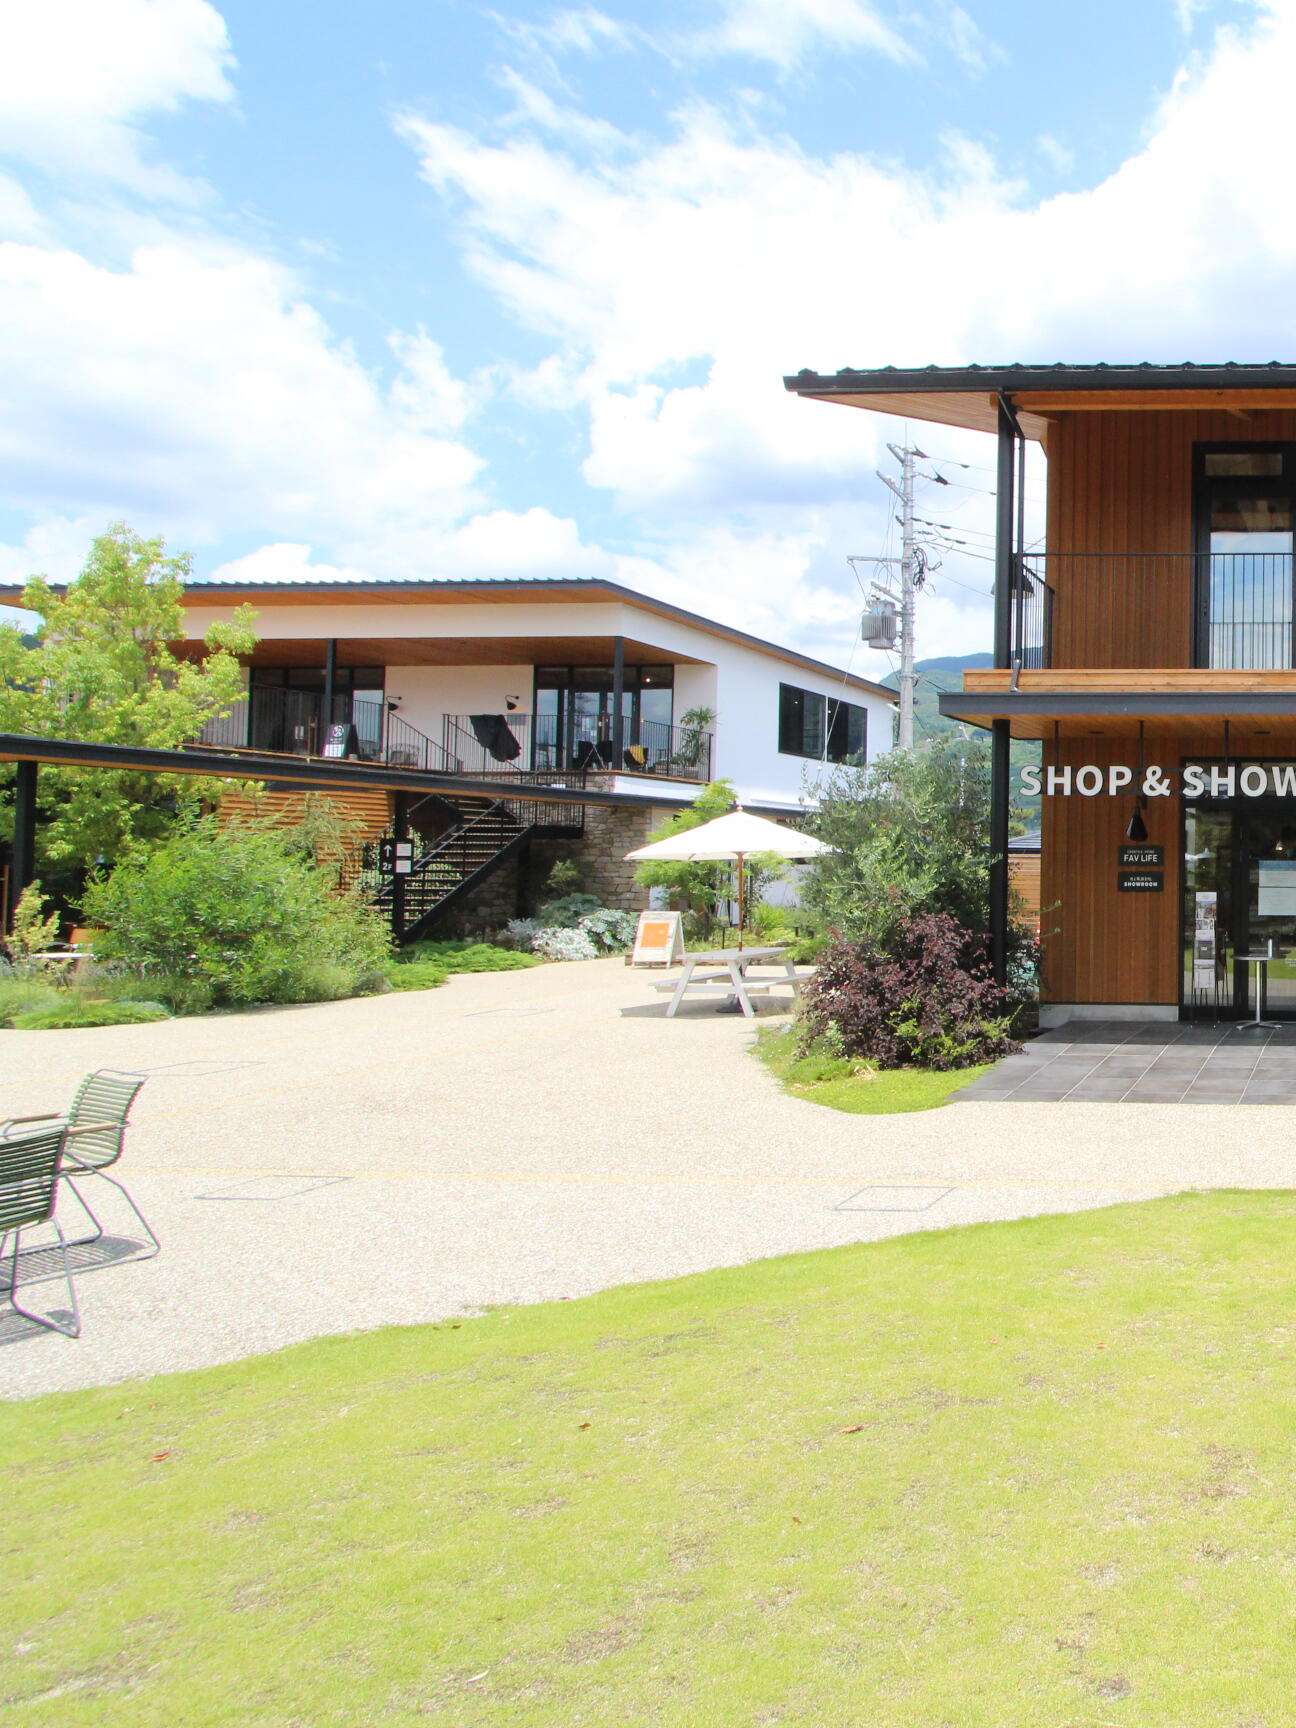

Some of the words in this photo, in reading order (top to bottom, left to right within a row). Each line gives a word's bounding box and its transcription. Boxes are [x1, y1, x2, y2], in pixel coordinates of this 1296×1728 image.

[1020, 765, 1132, 797] SHOP
[1142, 765, 1171, 797] &
[1124, 854, 1140, 862] FAV
[1141, 854, 1158, 862] LIFE
[382, 862, 393, 871] 2F
